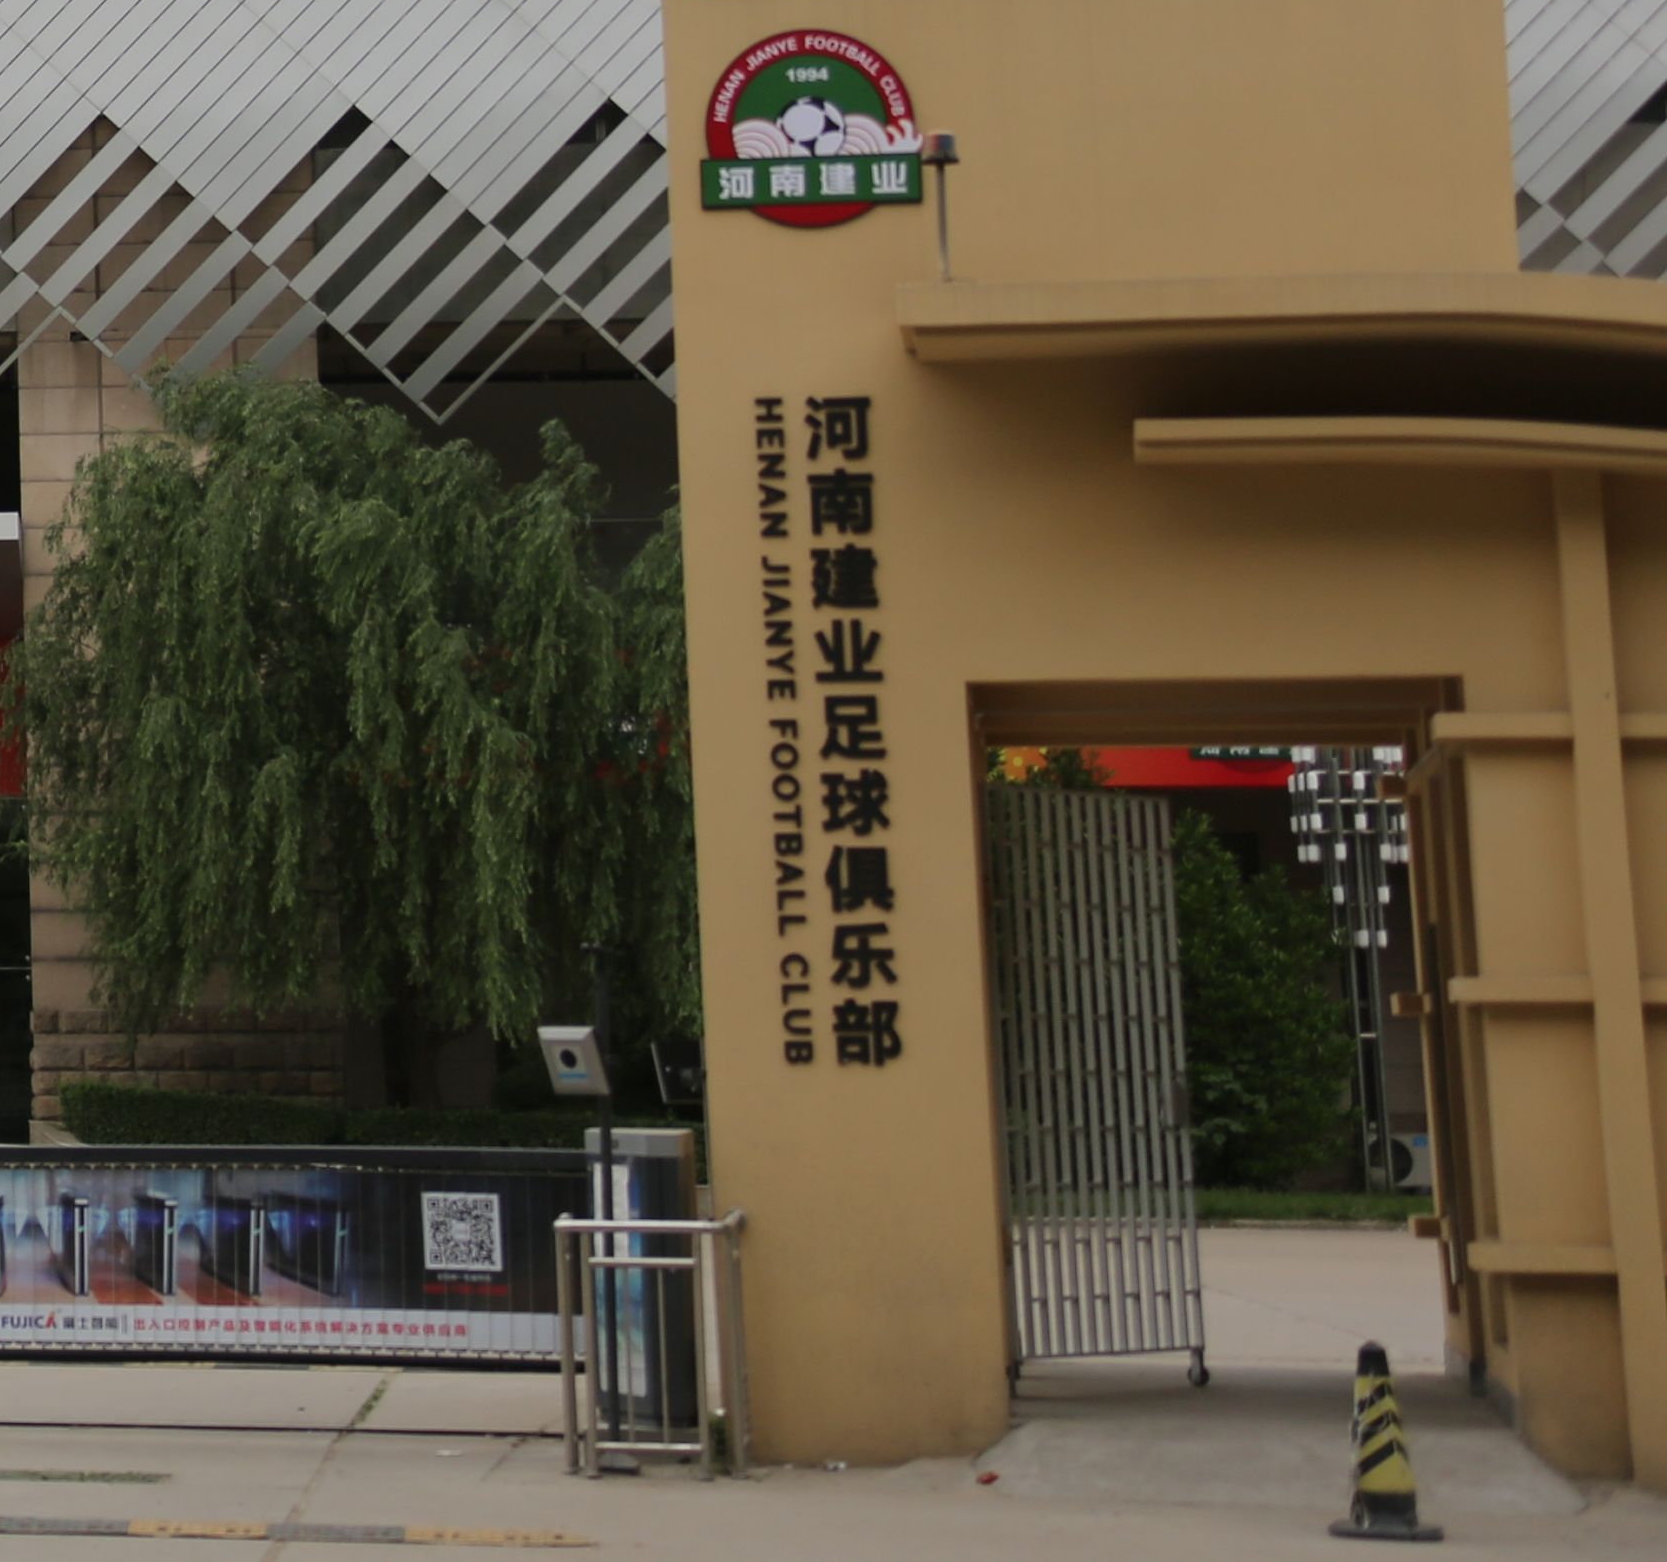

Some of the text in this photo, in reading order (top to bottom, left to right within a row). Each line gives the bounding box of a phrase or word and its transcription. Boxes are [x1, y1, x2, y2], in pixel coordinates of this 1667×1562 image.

[714, 35, 906, 122] HENAN JIANYE FOOTBALL CLUB
[786, 67, 829, 82] 1994
[718, 161, 908, 199] 河南建业
[754, 397, 814, 1067] HENAN JIANYE FOOTBALL CLUB
[804, 395, 904, 1068] 河南建业足球俱乐部
[1, 1311, 57, 1330] FUJICA
